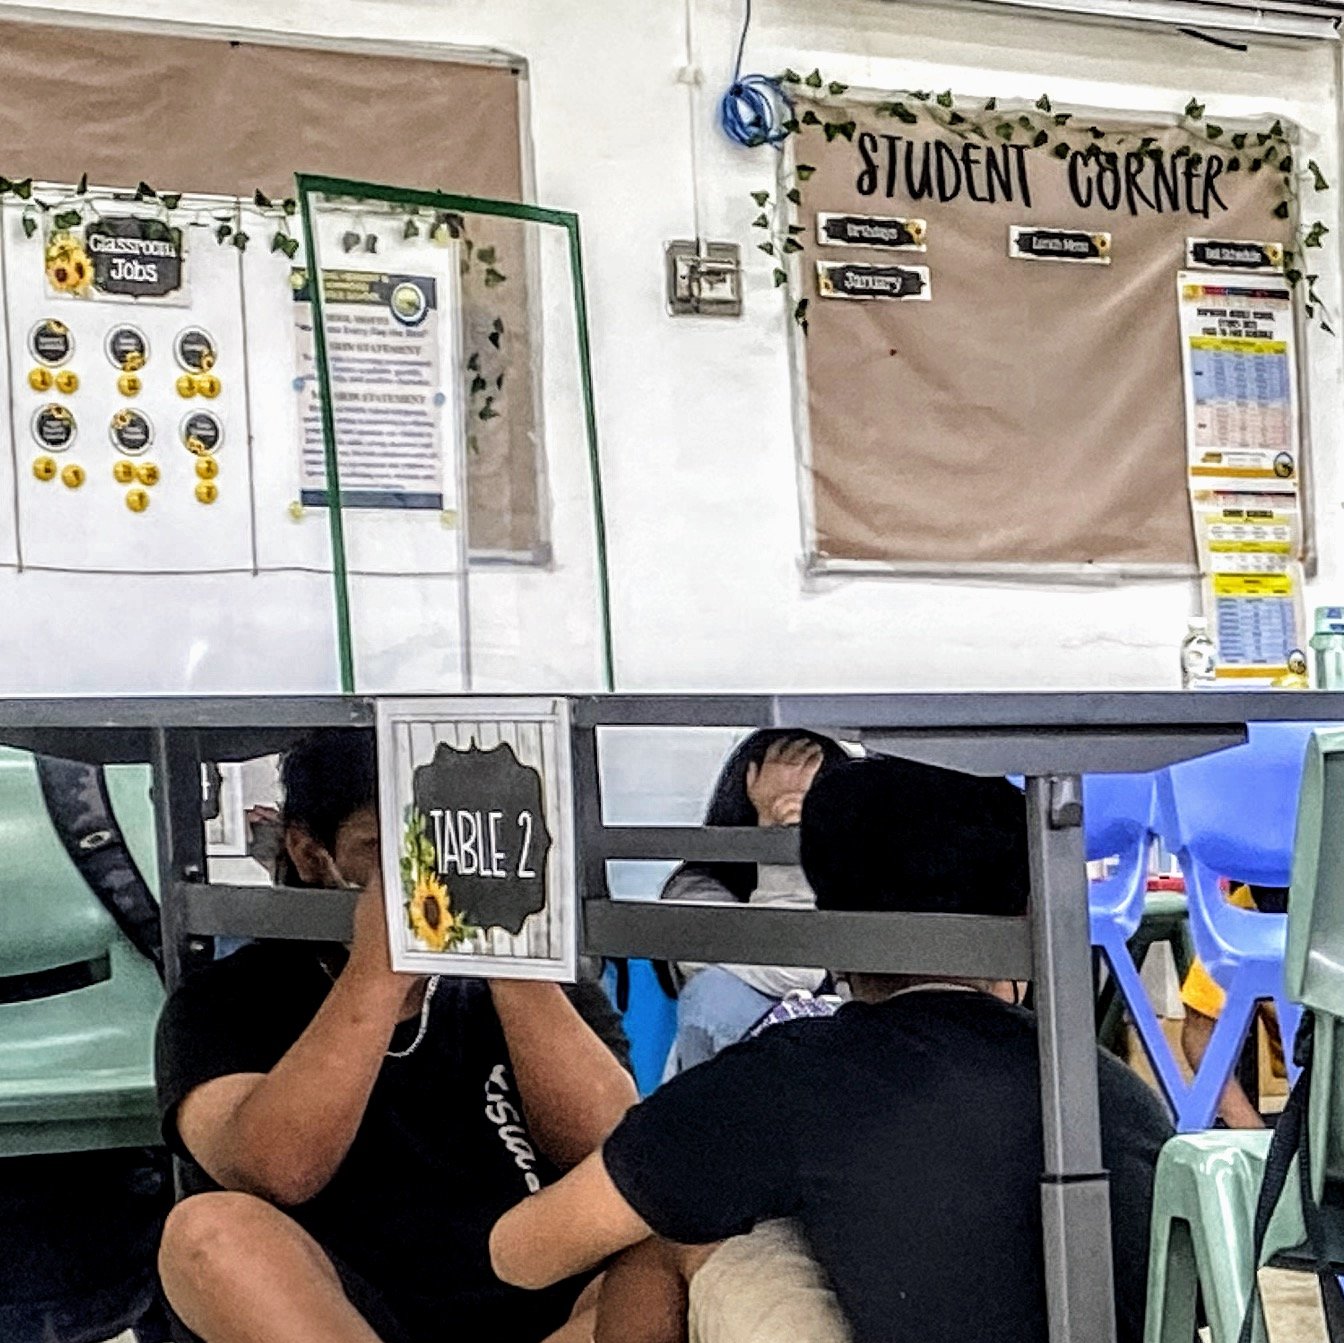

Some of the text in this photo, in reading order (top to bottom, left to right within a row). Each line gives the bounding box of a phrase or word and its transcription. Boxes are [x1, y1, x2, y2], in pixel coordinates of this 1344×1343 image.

[857, 132, 1228, 219] STUDENT CORNER
[110, 258, 158, 282] Jobs
[430, 810, 536, 878] TABLE 2
